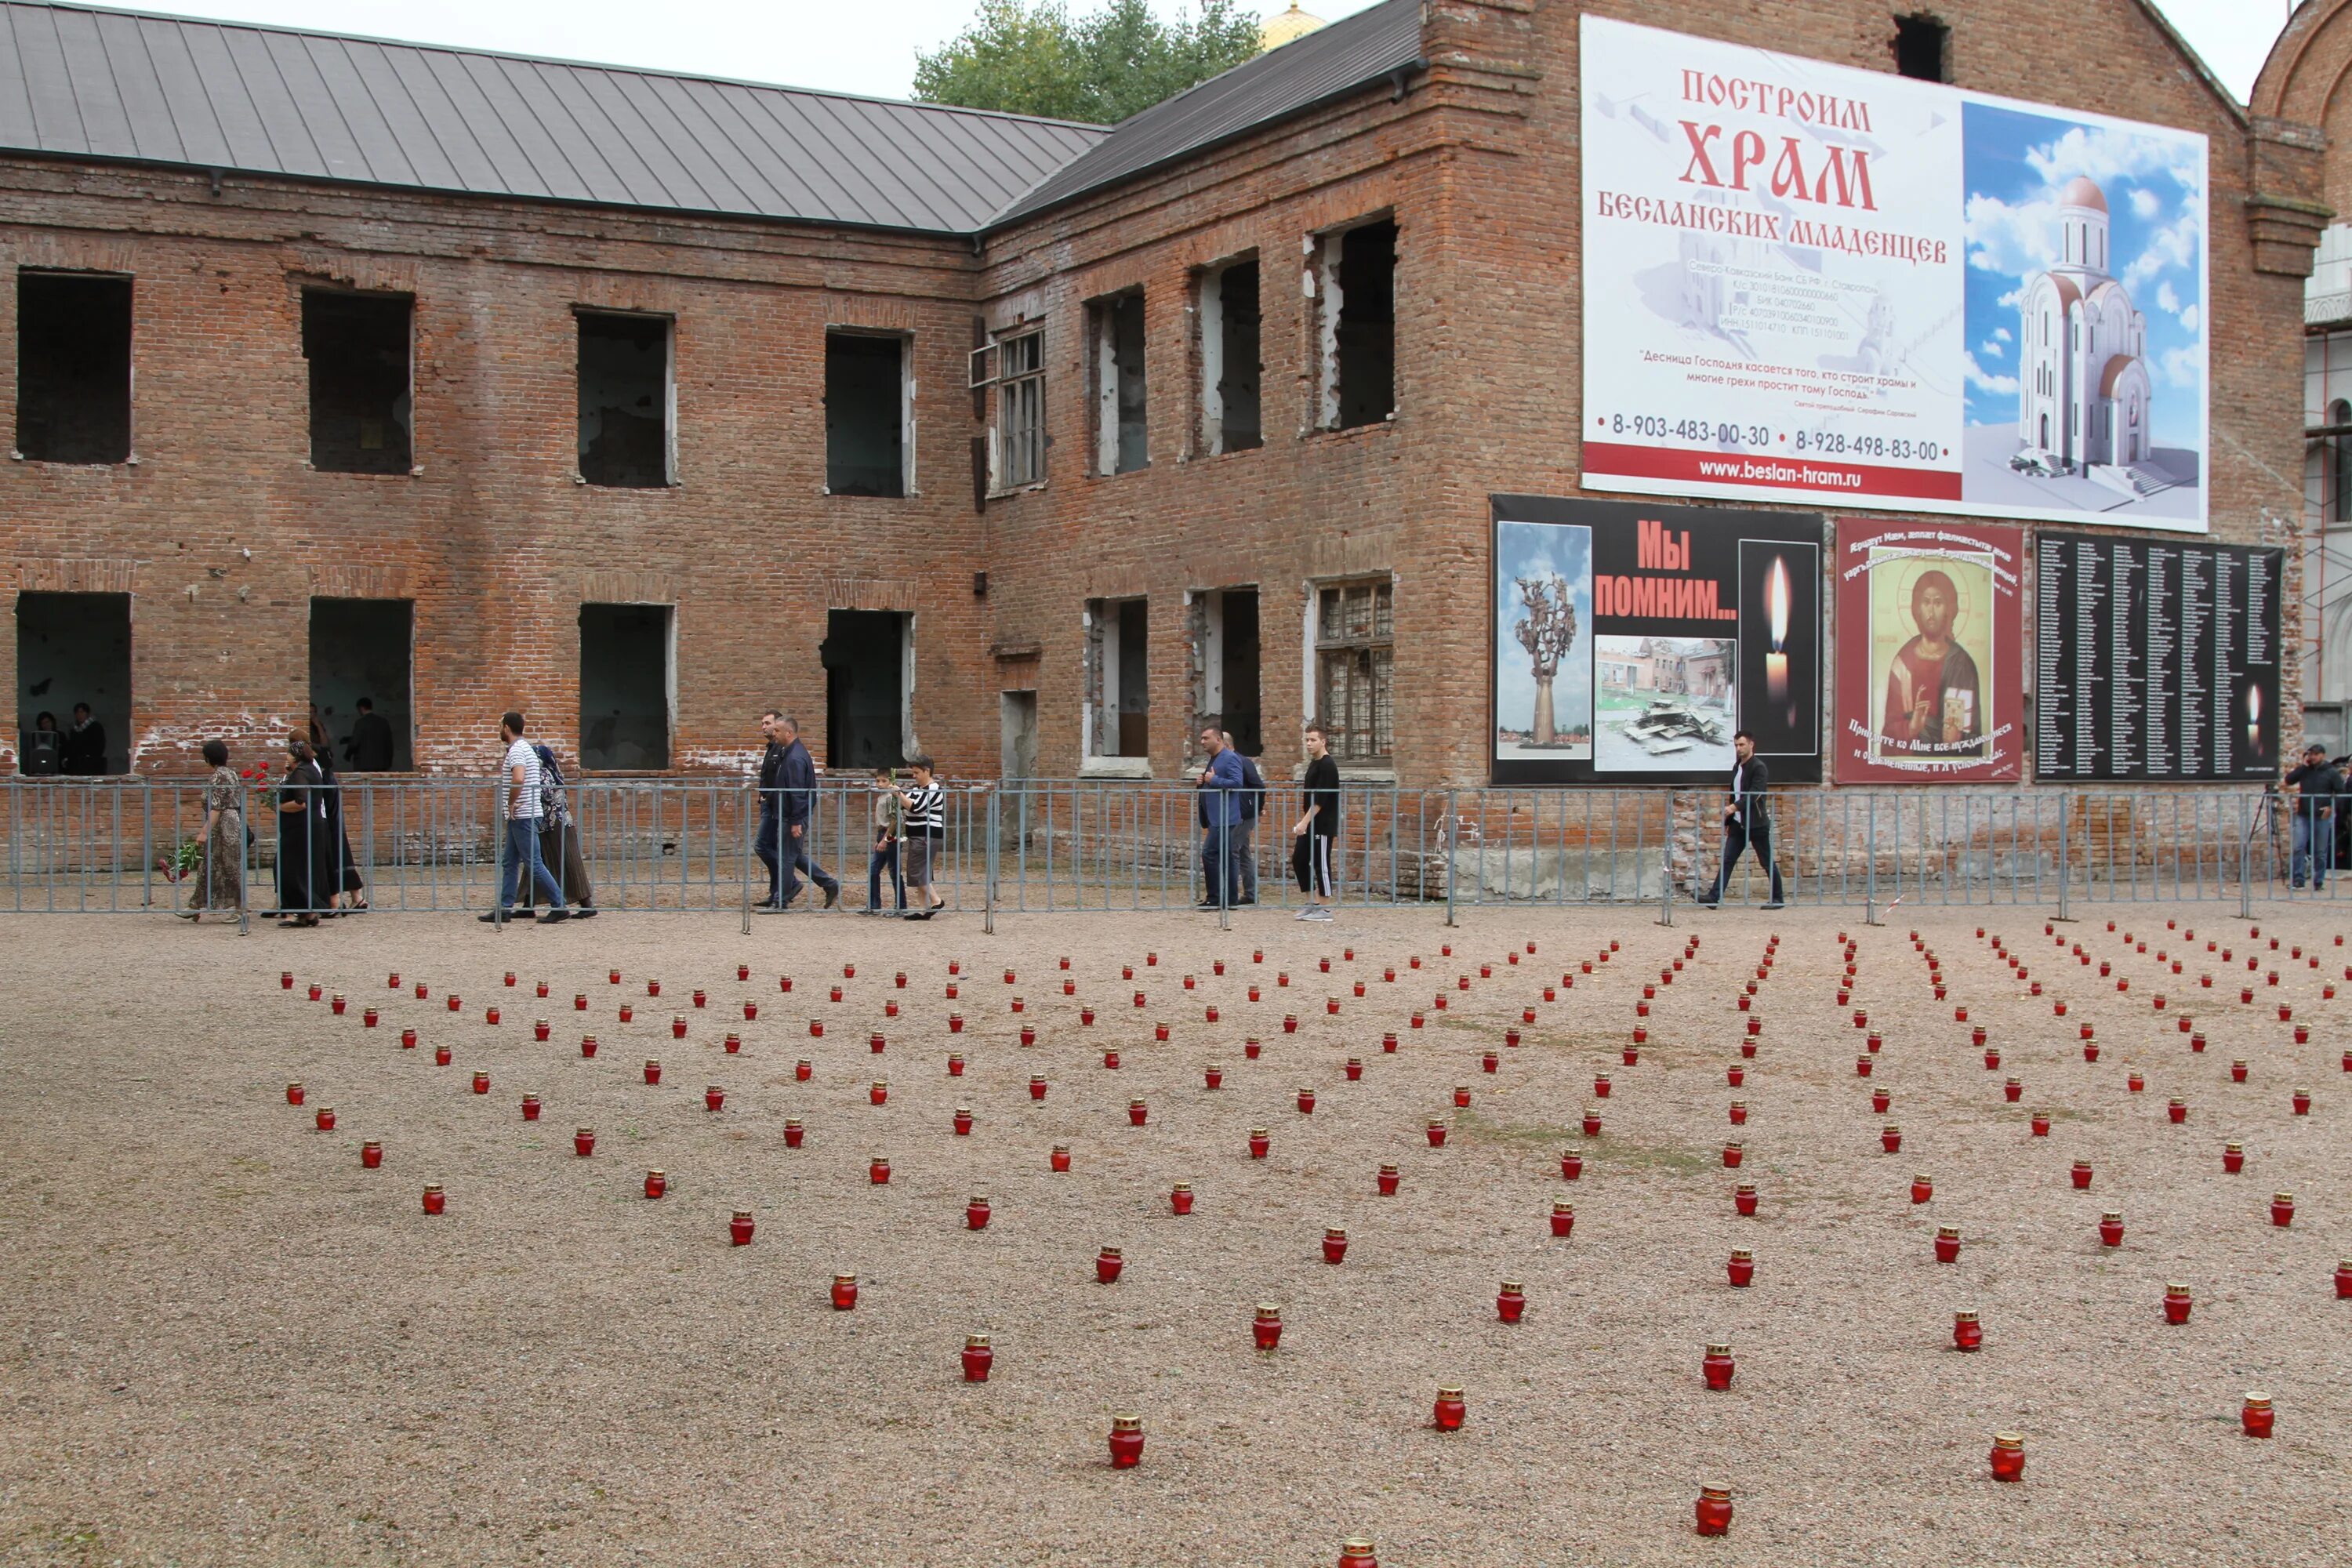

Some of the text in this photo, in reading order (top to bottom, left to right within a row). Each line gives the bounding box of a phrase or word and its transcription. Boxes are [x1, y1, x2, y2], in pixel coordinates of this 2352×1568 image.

[1681, 69, 1873, 132] ПОСТРОИМ
[1678, 120, 1878, 211] ХРАМ
[1598, 191, 1946, 267] БЕСЛАНСКИХ МЛАДЕНЦЕВ
[1757, 295, 1773, 305] БИК
[1721, 317, 1738, 327] ИНН
[1792, 325, 1808, 336] КПП
[1686, 372, 1724, 385] многие
[1726, 376, 1755, 387] грехи
[1758, 379, 1798, 391] простит
[1802, 383, 1826, 397] тому
[1695, 355, 1743, 370] Господня
[1745, 362, 1792, 376] касается
[1796, 368, 1820, 380] того,
[1822, 372, 1838, 381] кто
[1840, 373, 1875, 385] строит
[1877, 376, 1908, 388] храмы
[1910, 380, 1917, 389] и
[1613, 413, 1938, 461] 8-903-483-00-30 8-928-498-83-00
[1699, 461, 1861, 488] www.beslan-hram.ru
[1638, 520, 1690, 570] Мы
[1853, 749, 1861, 758] и
[1933, 764, 1940, 772] и
[1896, 739, 1907, 750] ко
[1909, 739, 1932, 752] Мне
[1933, 742, 1950, 752] все
